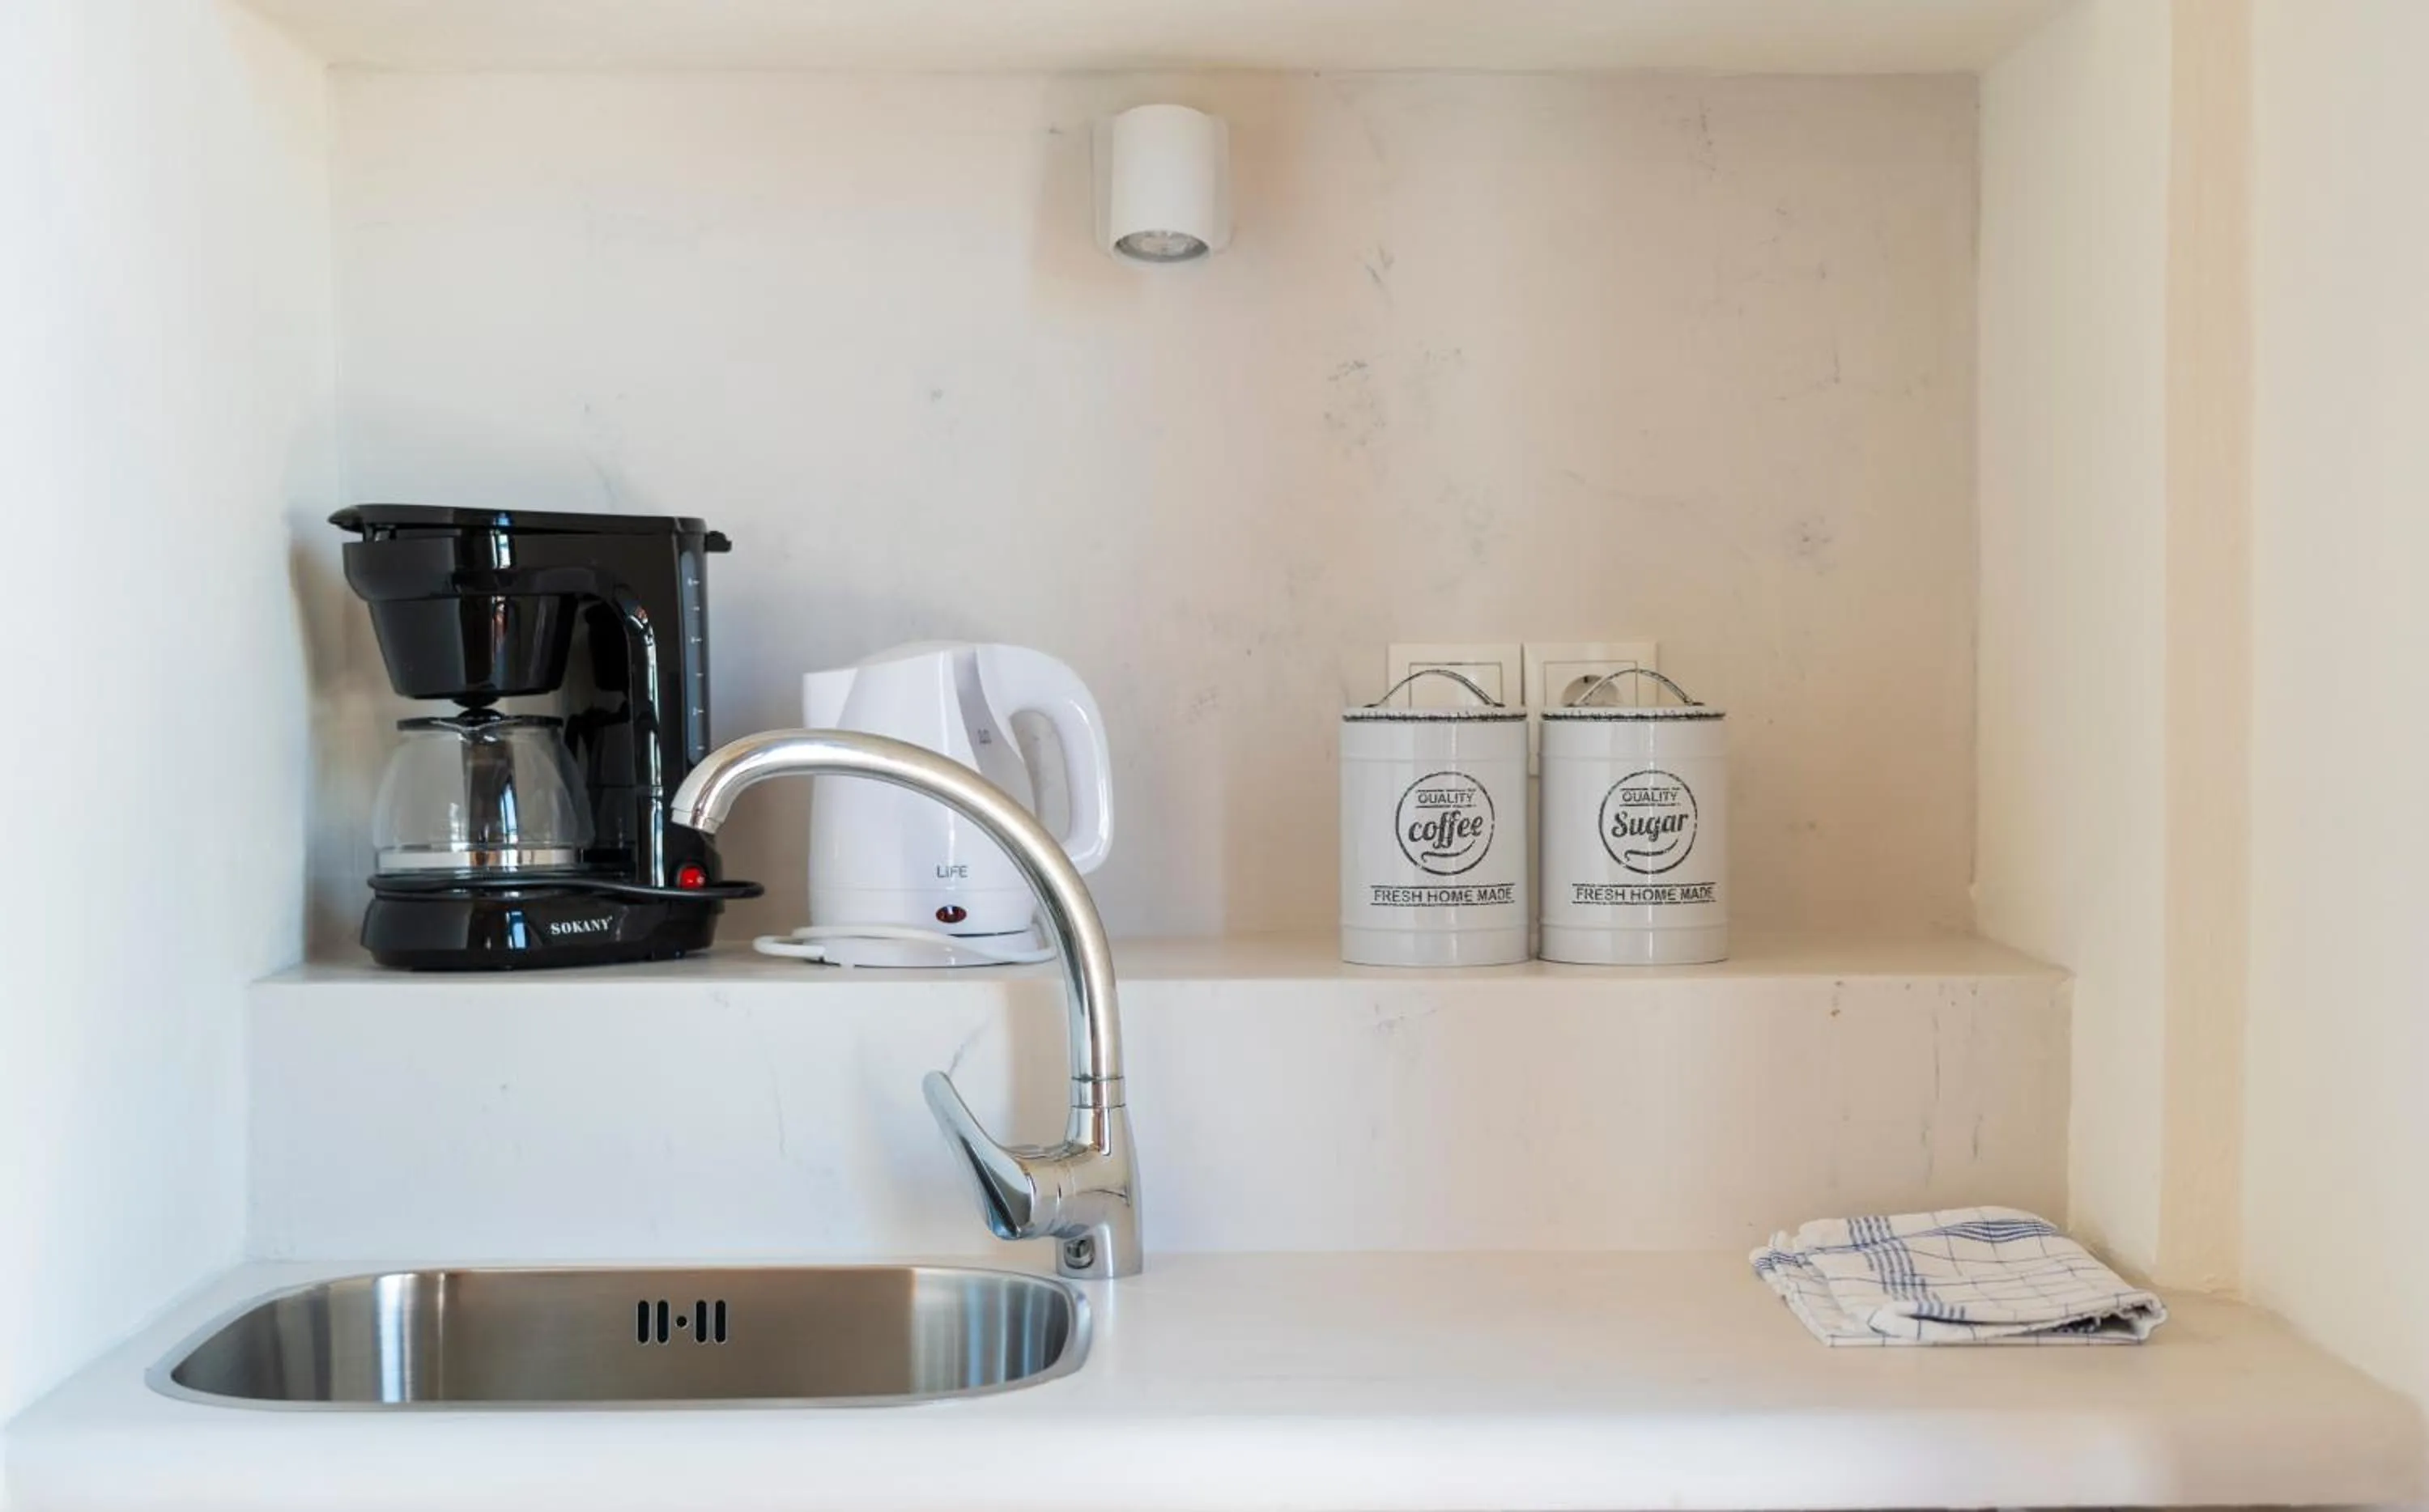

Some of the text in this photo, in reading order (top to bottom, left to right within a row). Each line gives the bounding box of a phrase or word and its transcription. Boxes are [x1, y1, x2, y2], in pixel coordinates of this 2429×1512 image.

[1418, 792, 1474, 804] QUALITY
[1622, 791, 1678, 802] QUALITY
[1408, 809, 1483, 849] coffee
[1610, 810, 1689, 843] Sugar
[1374, 887, 1513, 903] FRESH HOME MADE
[1576, 886, 1714, 901] FRESH HOME MADE
[550, 918, 610, 936] SOKANY
